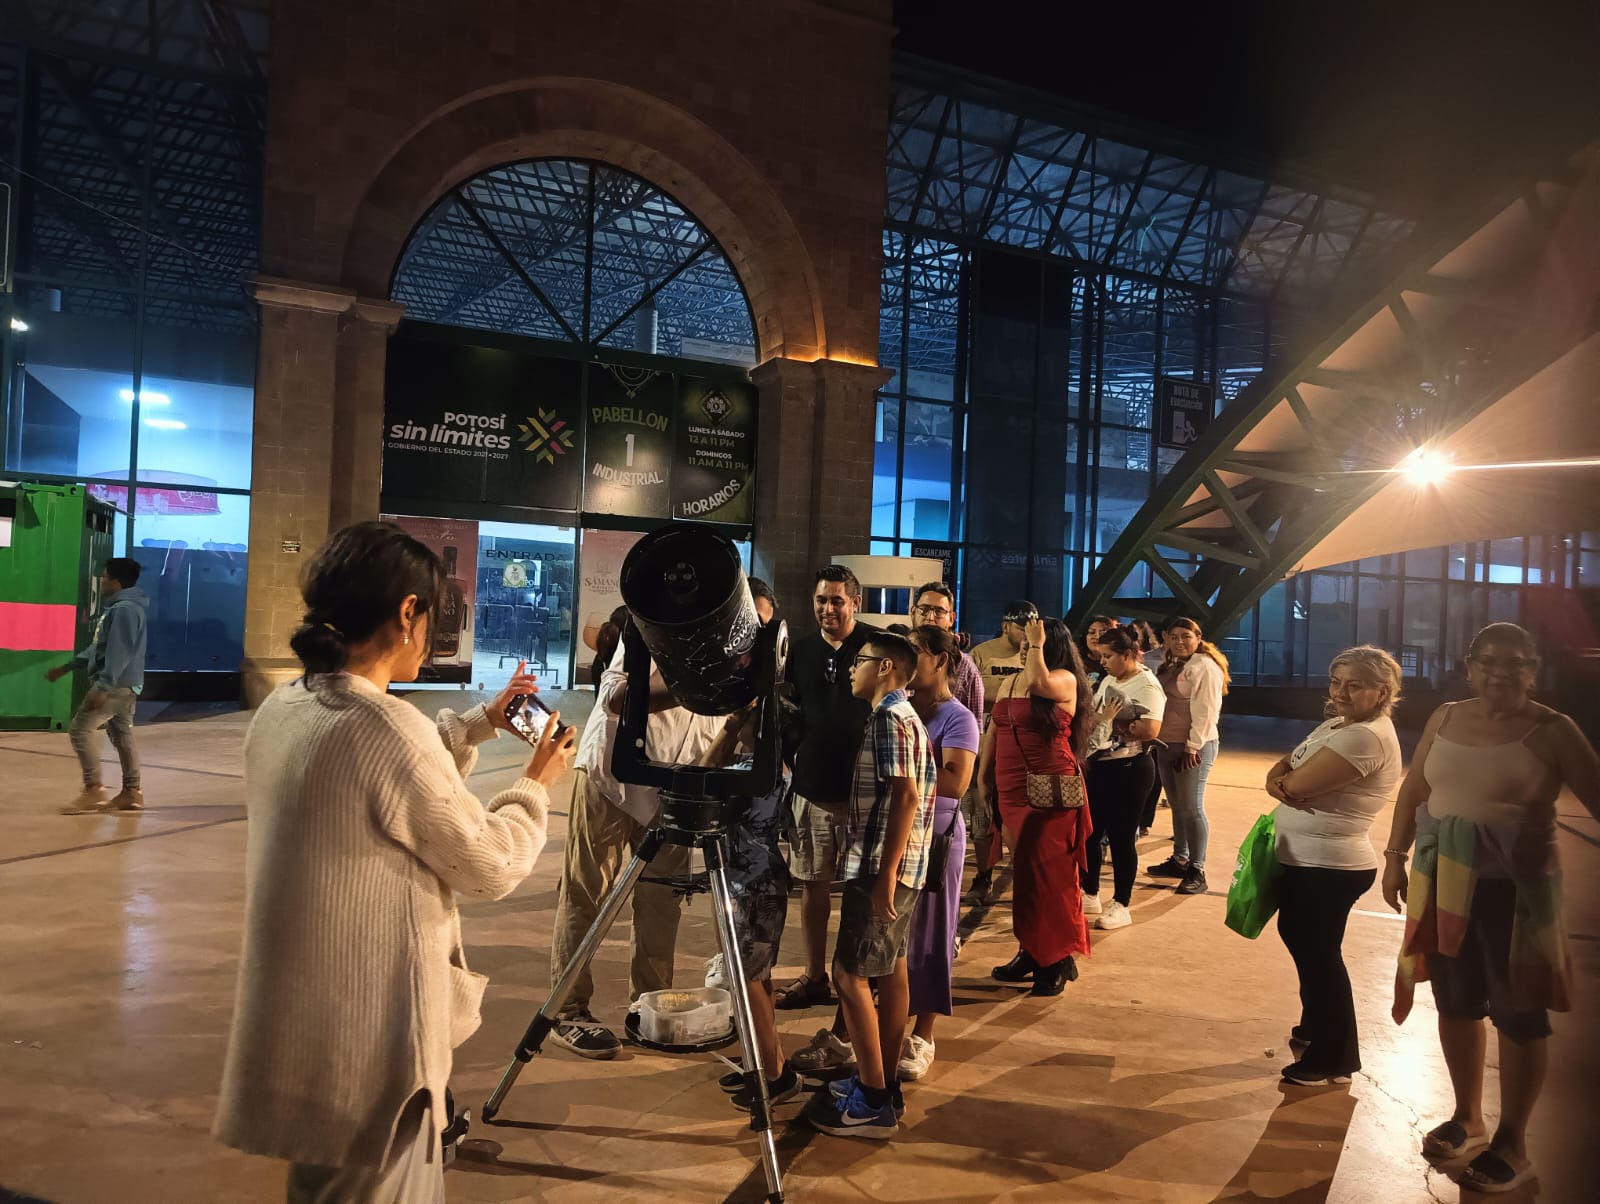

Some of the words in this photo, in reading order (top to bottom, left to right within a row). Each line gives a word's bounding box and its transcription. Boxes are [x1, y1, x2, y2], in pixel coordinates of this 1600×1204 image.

[444, 412, 507, 430] POTOSÍ
[390, 420, 427, 441] sin
[429, 423, 511, 450] límites
[688, 426, 710, 435] LUNES
[717, 429, 745, 438] SÁBADO
[688, 434, 699, 444] 12
[700, 436, 708, 445] A
[710, 438, 718, 446] 11
[719, 438, 735, 447] PM
[388, 442, 426, 451] GOBIERNO
[428, 446, 443, 454] DEL
[444, 448, 472, 457] ESTADO
[625, 433, 635, 467] 1
[688, 457, 696, 465] 11
[697, 458, 714, 467] AM
[715, 460, 723, 468] A
[725, 461, 733, 469] 11
[592, 462, 664, 485] INDUSTRIAL
[682, 479, 741, 515] HORARIOS
[486, 549, 564, 562] ENTRADA
